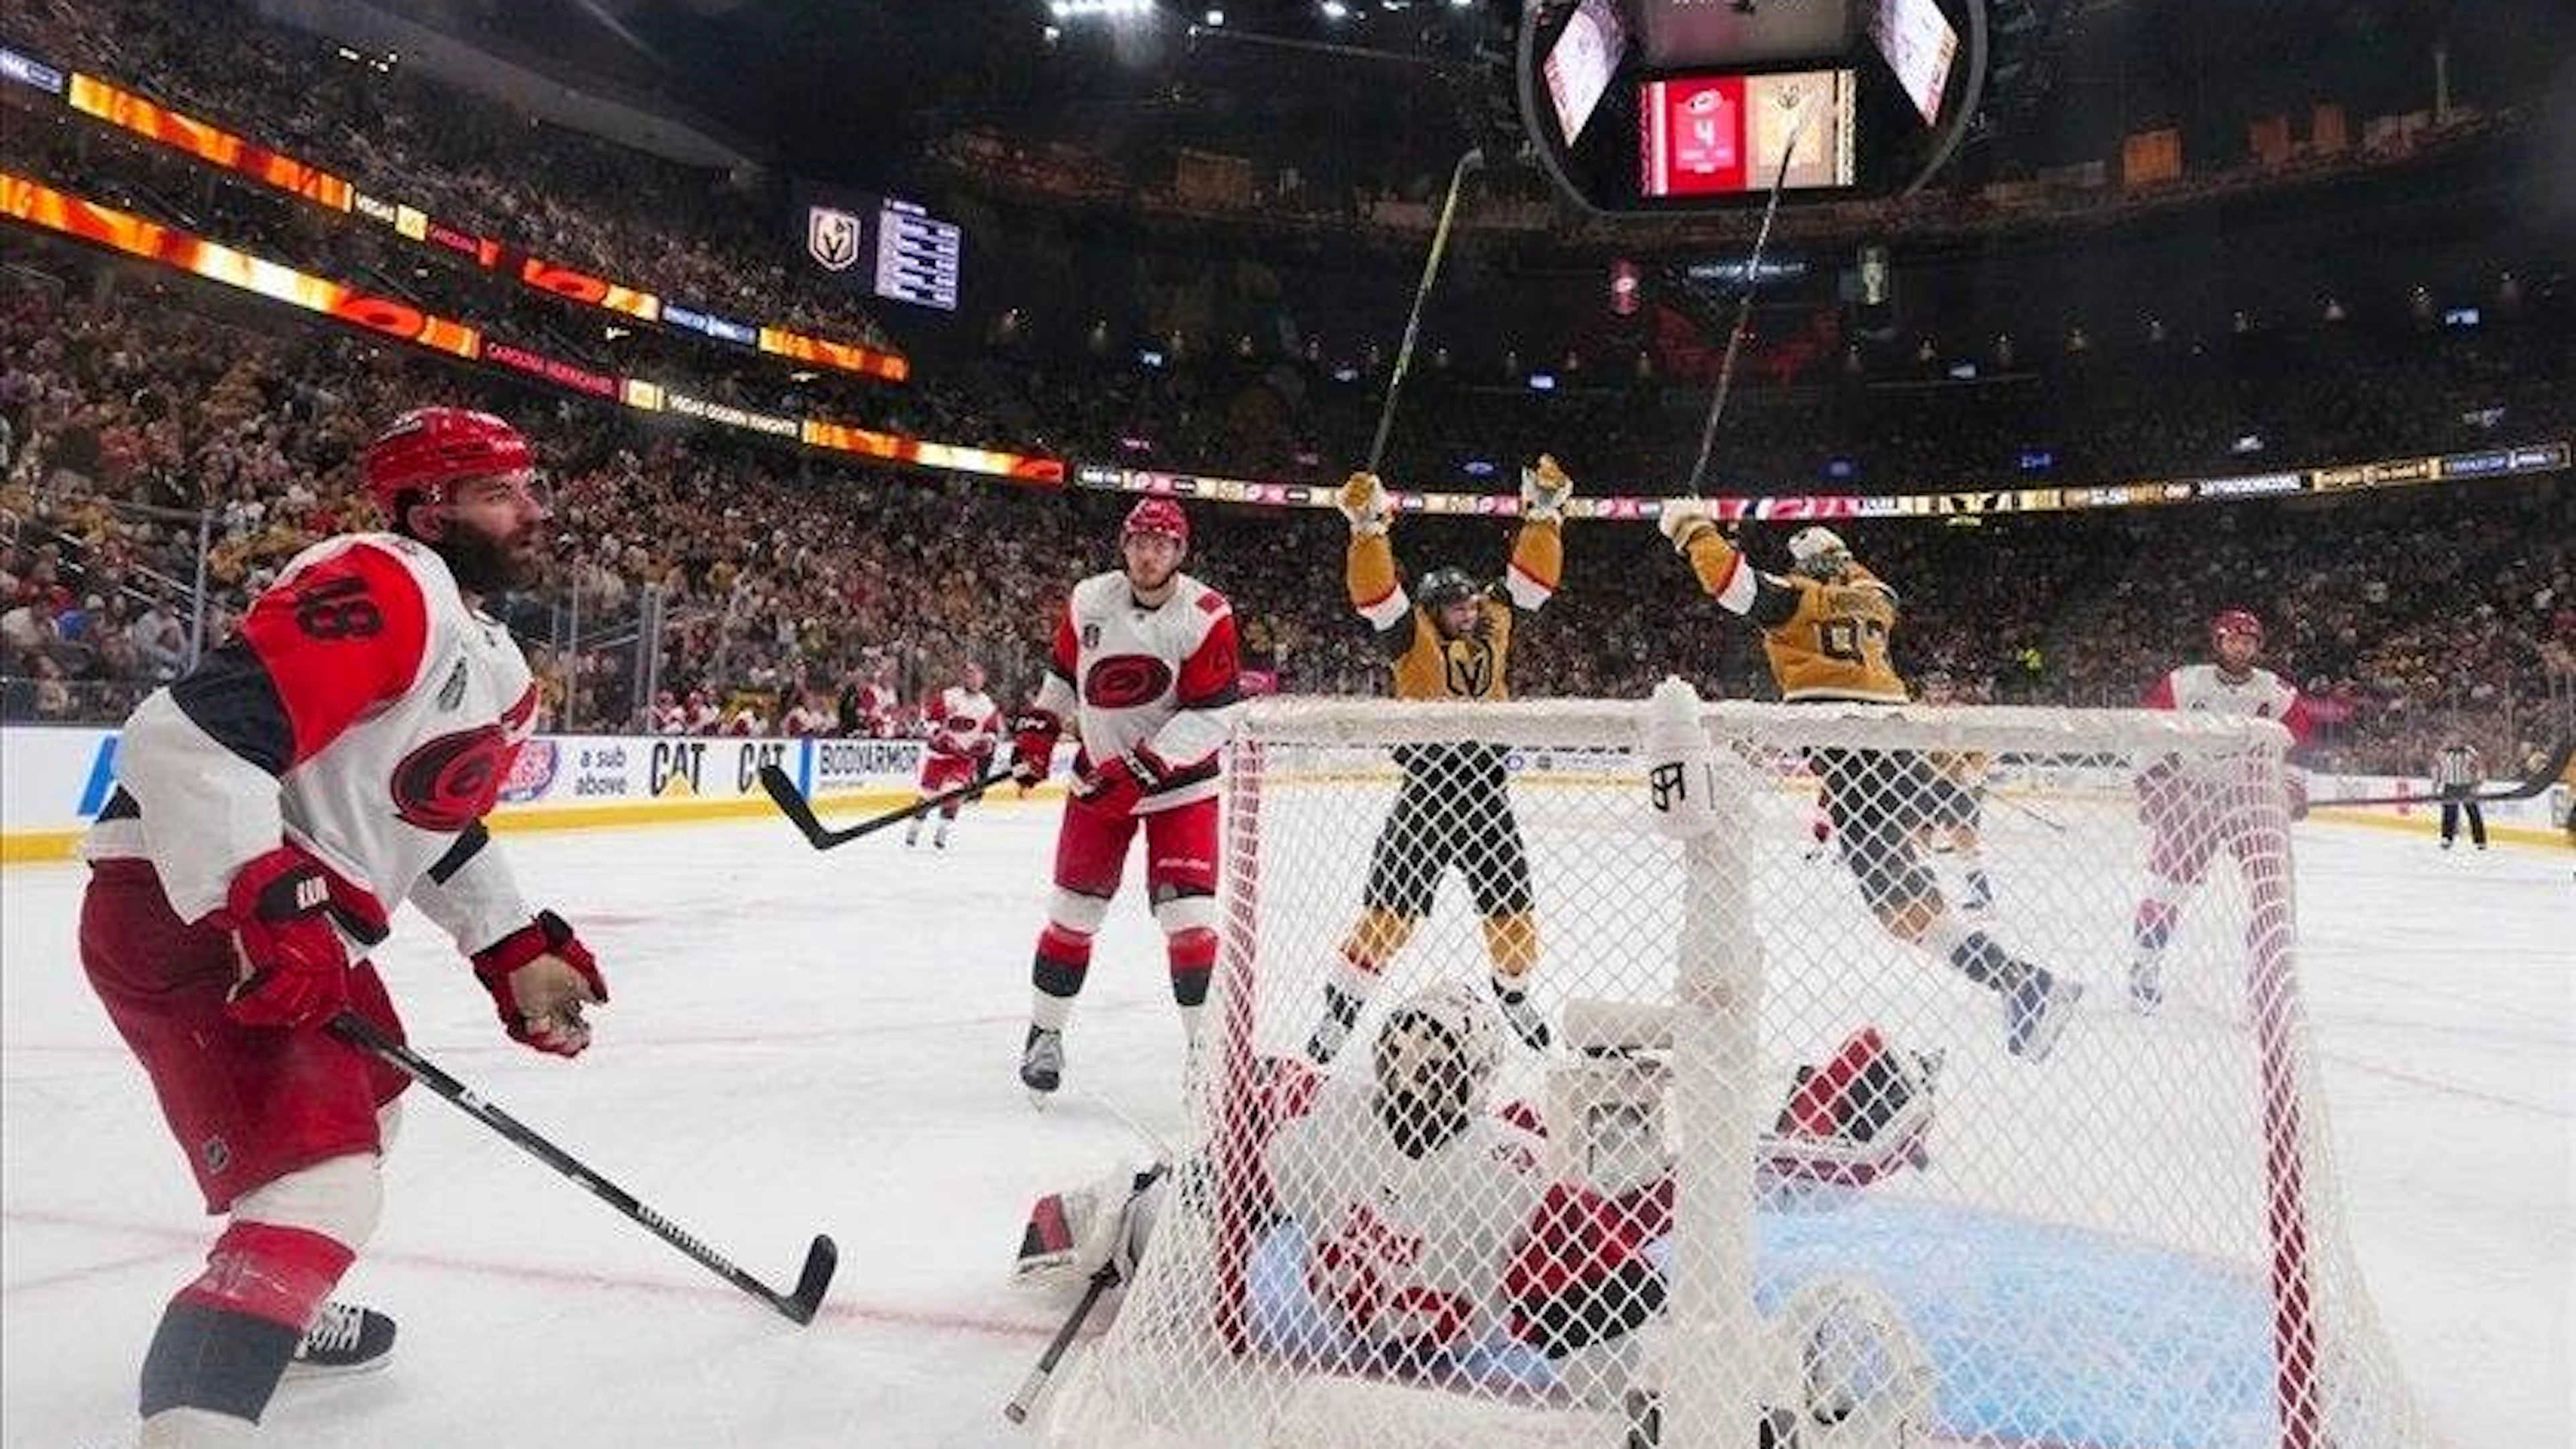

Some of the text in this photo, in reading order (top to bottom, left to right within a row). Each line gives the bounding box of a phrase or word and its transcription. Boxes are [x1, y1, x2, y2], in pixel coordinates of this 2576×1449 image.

[580, 745, 627, 767] a sub
[820, 744, 921, 775] BODYARMOR
[652, 743, 706, 796] CAT
[576, 774, 627, 795] above
